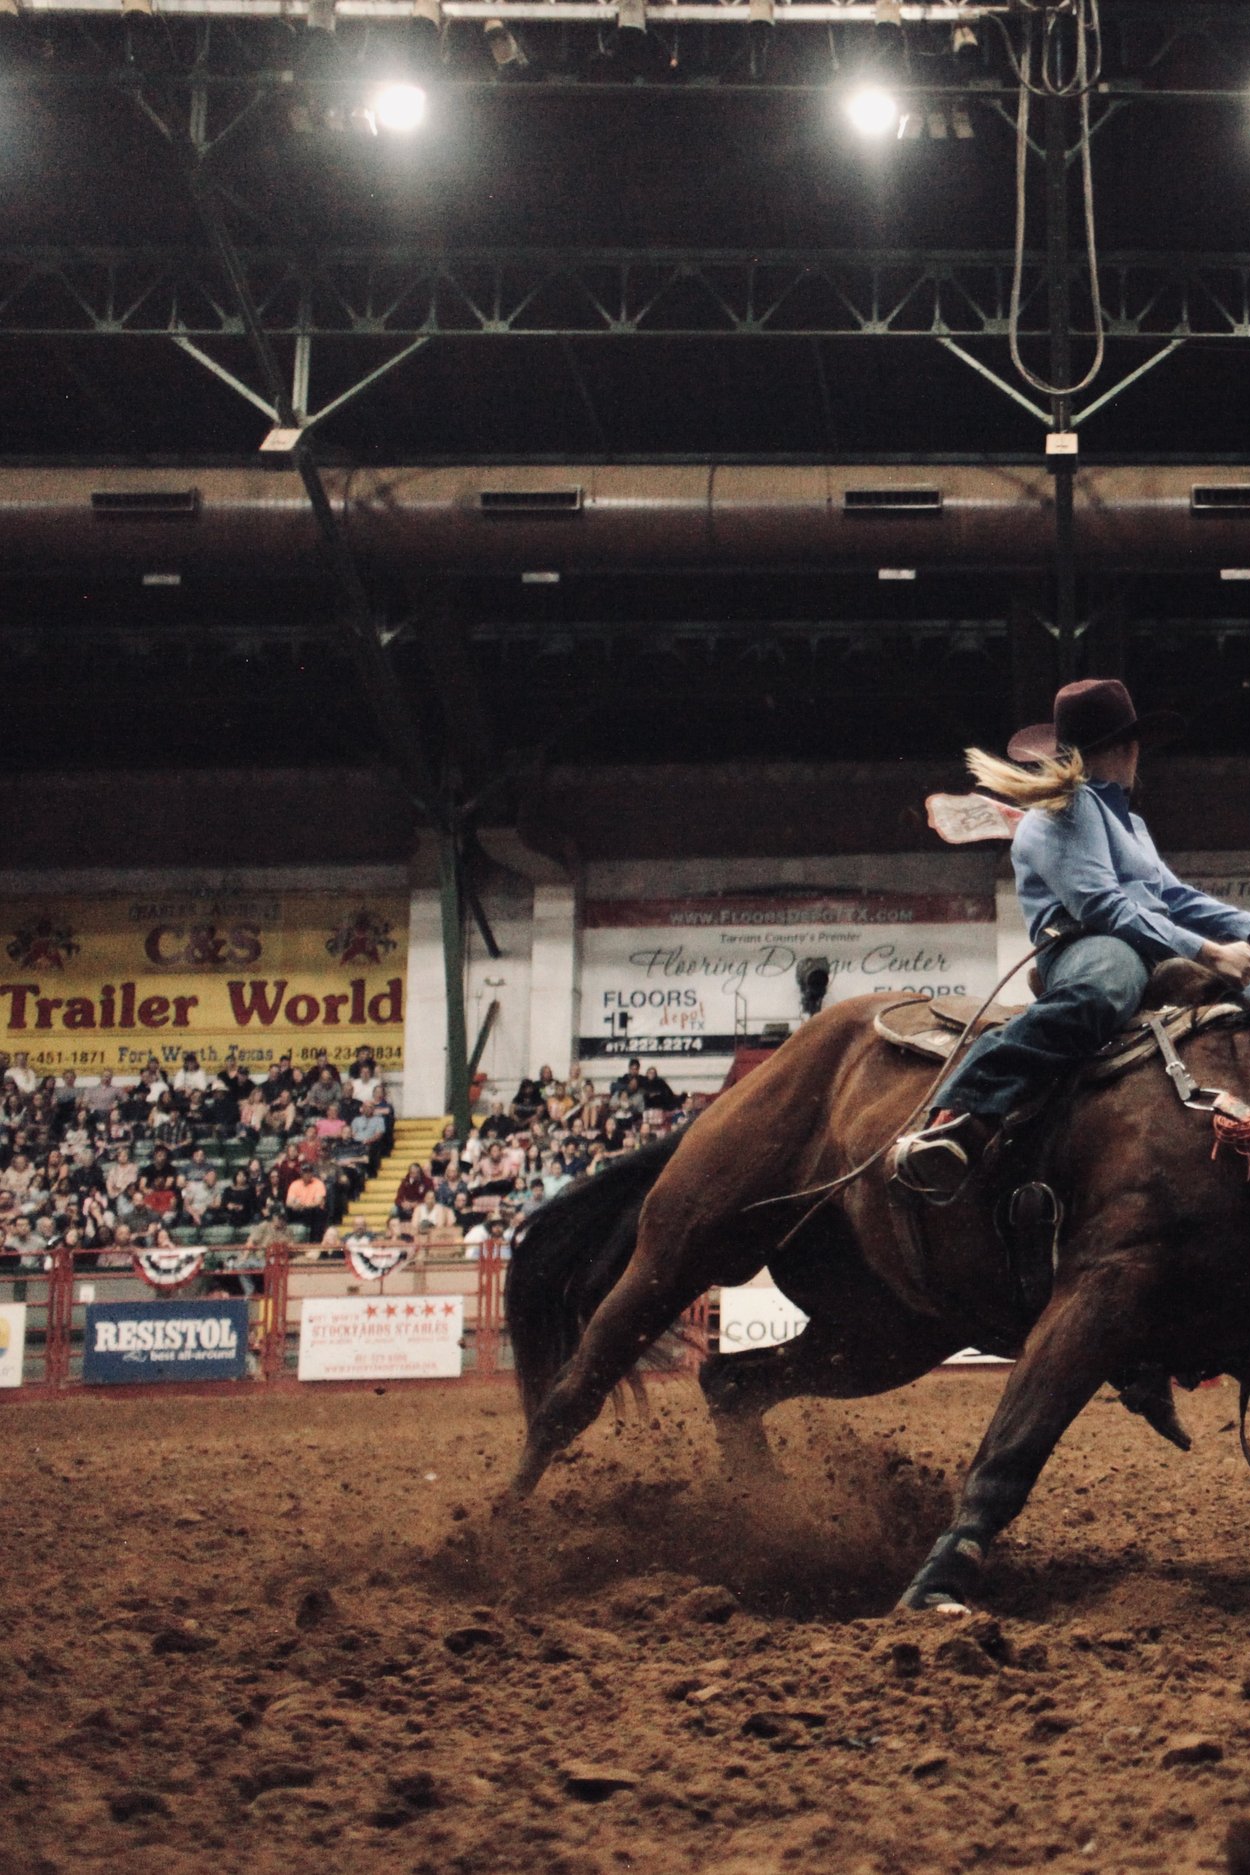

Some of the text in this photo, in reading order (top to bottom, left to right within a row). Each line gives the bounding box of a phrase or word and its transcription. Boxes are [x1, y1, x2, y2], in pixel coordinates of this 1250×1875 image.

[144, 922, 262, 967] C&S
[720, 933, 761, 944] Tarrant
[818, 931, 862, 943] Premier
[629, 944, 749, 994] Flooring
[862, 944, 951, 975] Center
[0, 977, 404, 1030] Trailer World
[603, 988, 698, 1009] FLOORS
[118, 1045, 152, 1063] Fort
[228, 1044, 273, 1062] Texas
[94, 1317, 238, 1352] RESISTOL
